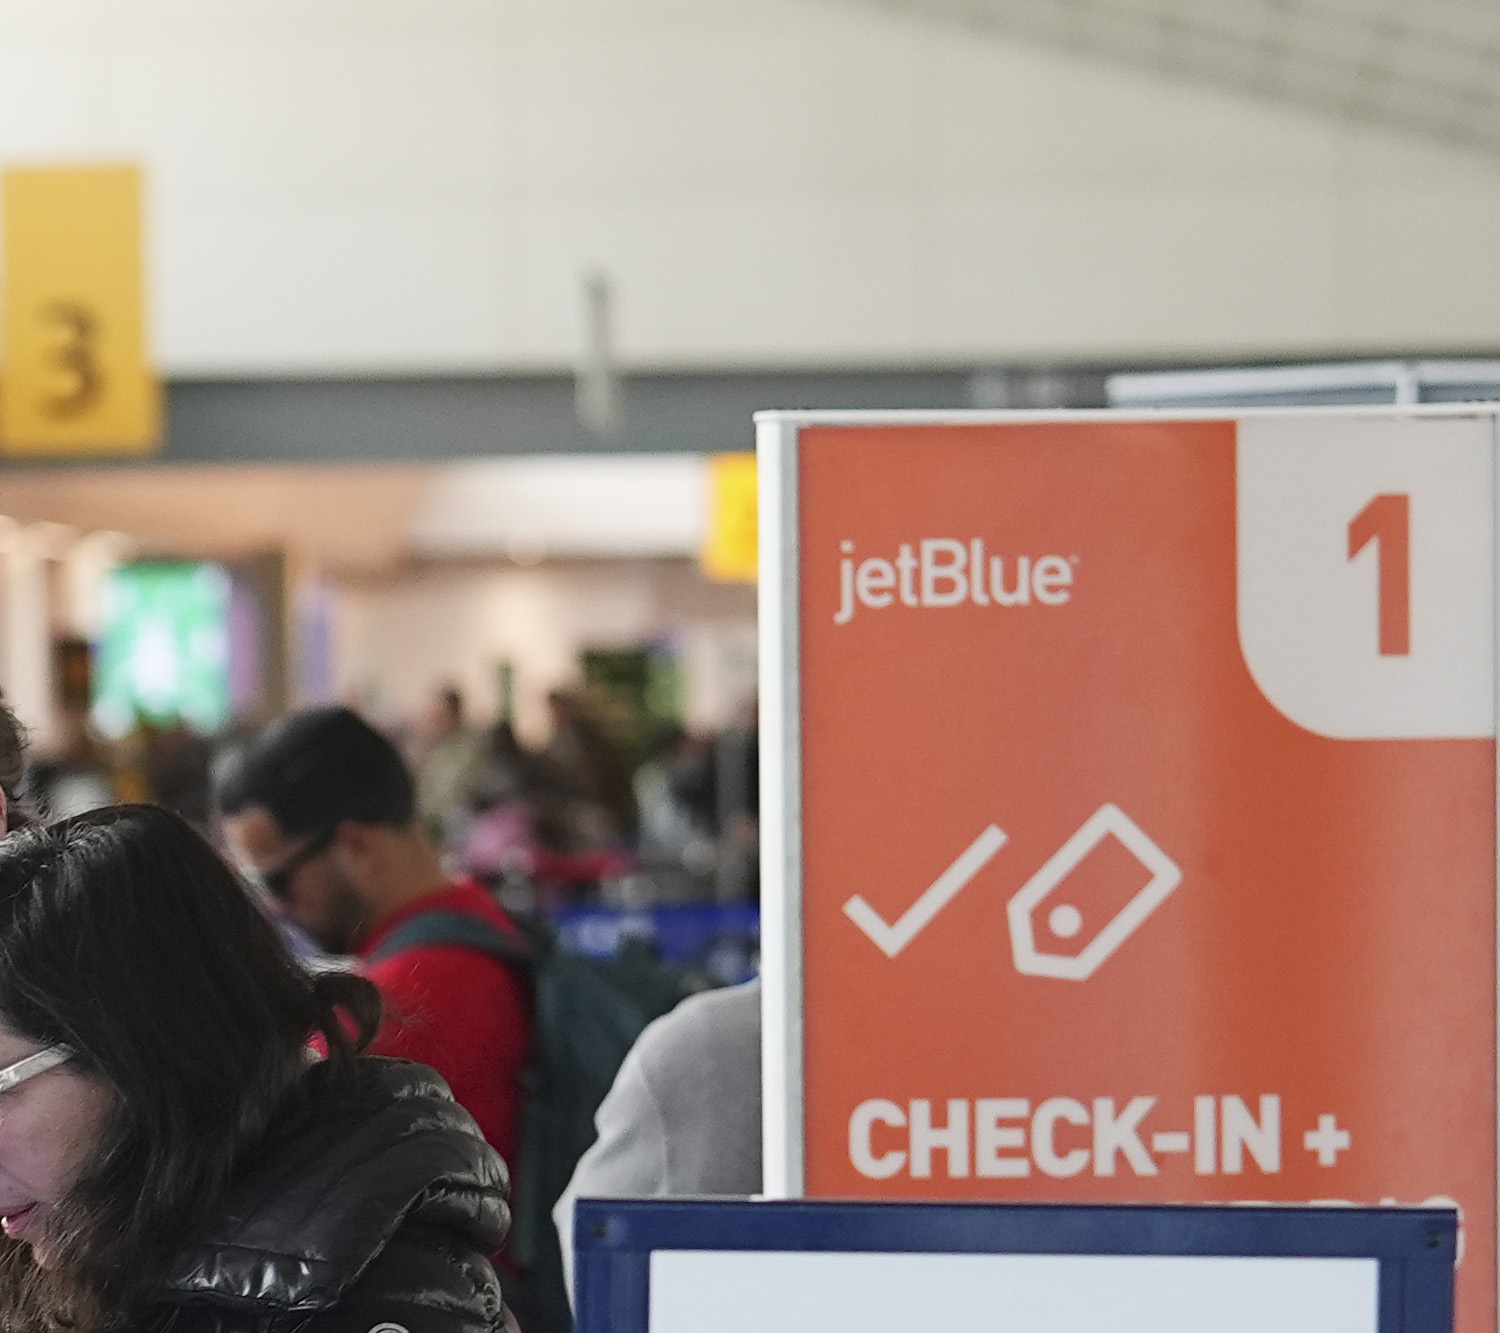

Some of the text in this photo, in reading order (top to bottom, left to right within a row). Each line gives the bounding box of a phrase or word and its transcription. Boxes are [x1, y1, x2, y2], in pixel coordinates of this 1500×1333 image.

[37, 297, 105, 421] 3
[833, 536, 1076, 625] jetBlue
[1348, 493, 1411, 656] 1
[848, 1094, 1350, 1178] CHECK-IN +
